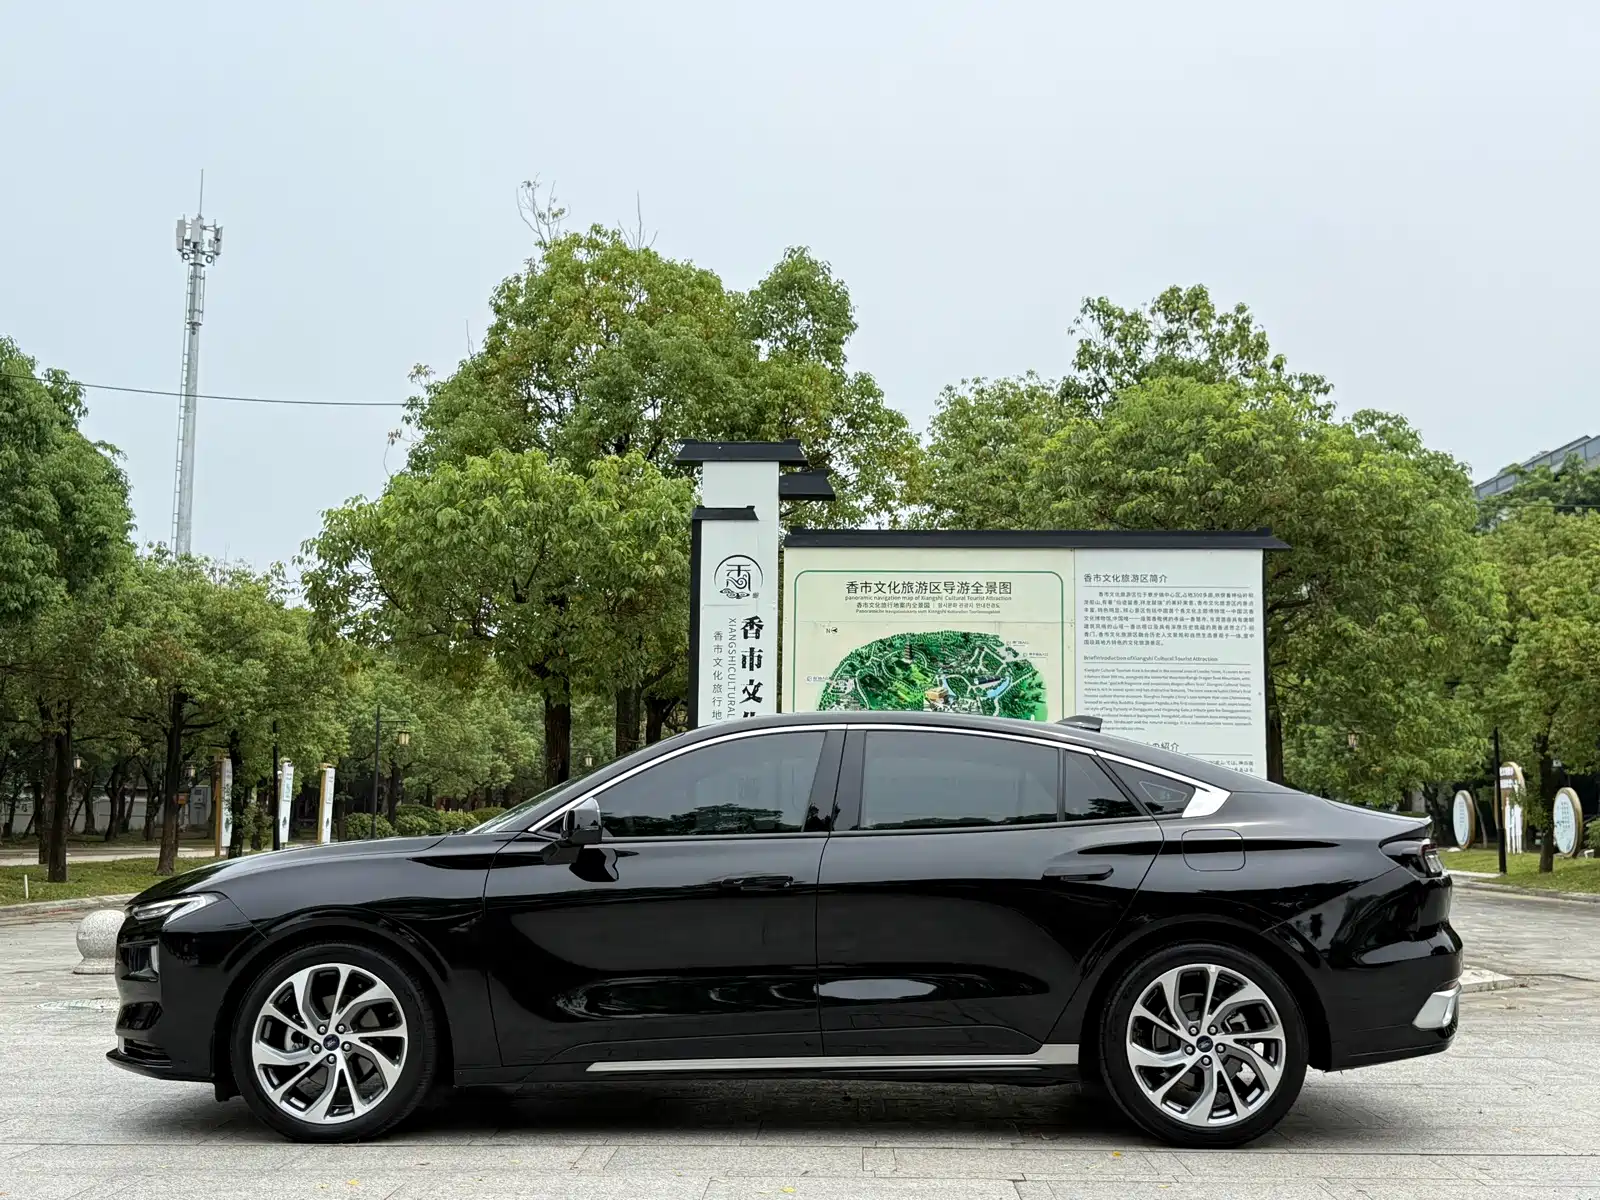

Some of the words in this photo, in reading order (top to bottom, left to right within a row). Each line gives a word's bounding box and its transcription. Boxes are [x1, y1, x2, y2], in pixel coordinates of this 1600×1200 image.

[845, 581, 1012, 595] 香市文化旅游区导游全景图
[1083, 573, 1168, 583] 香市文化旅游区简介
[712, 631, 724, 720] 香市文化旅行地
[739, 615, 764, 718] 香市文
